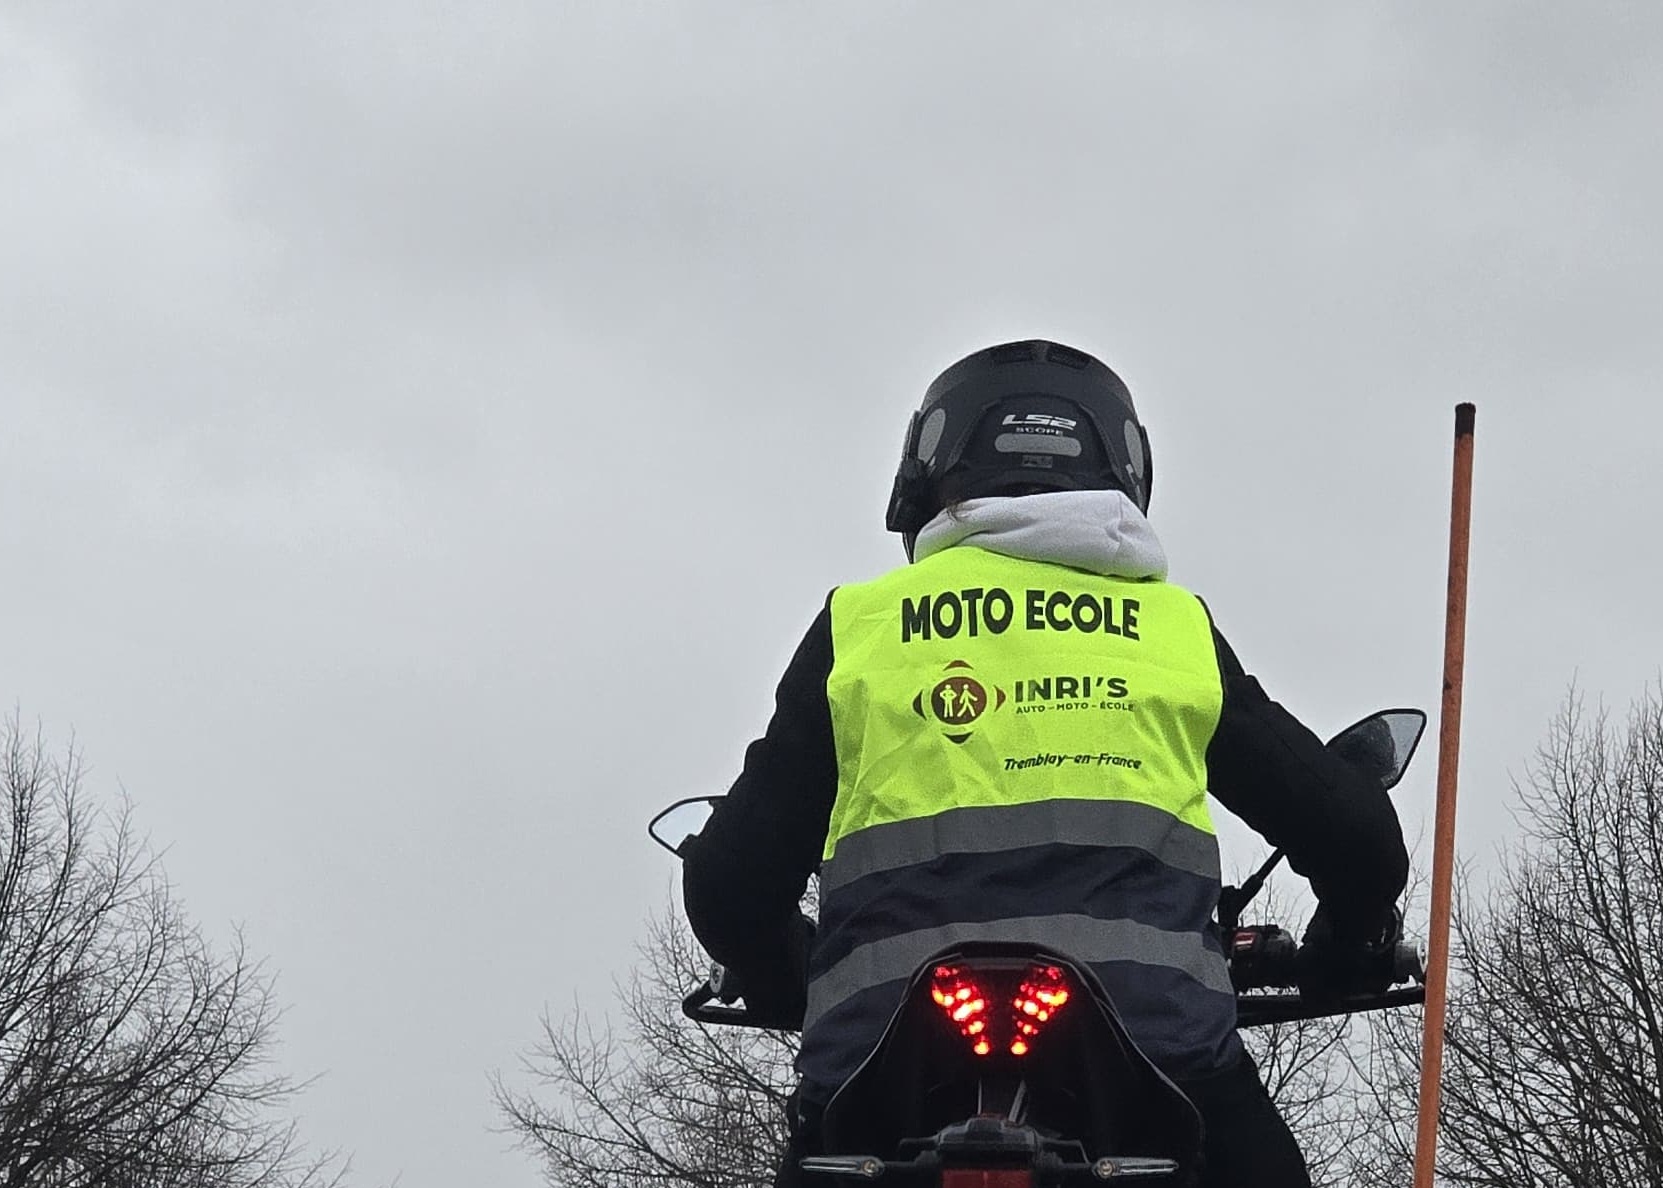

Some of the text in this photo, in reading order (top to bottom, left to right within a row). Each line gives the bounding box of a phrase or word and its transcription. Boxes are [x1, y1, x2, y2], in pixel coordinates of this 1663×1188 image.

[1002, 414, 1077, 431] LS2
[901, 587, 1141, 643] MOTO ECOLE
[1015, 676, 1129, 703] INRI'S
[1004, 752, 1142, 771] Tremblay-en-France
